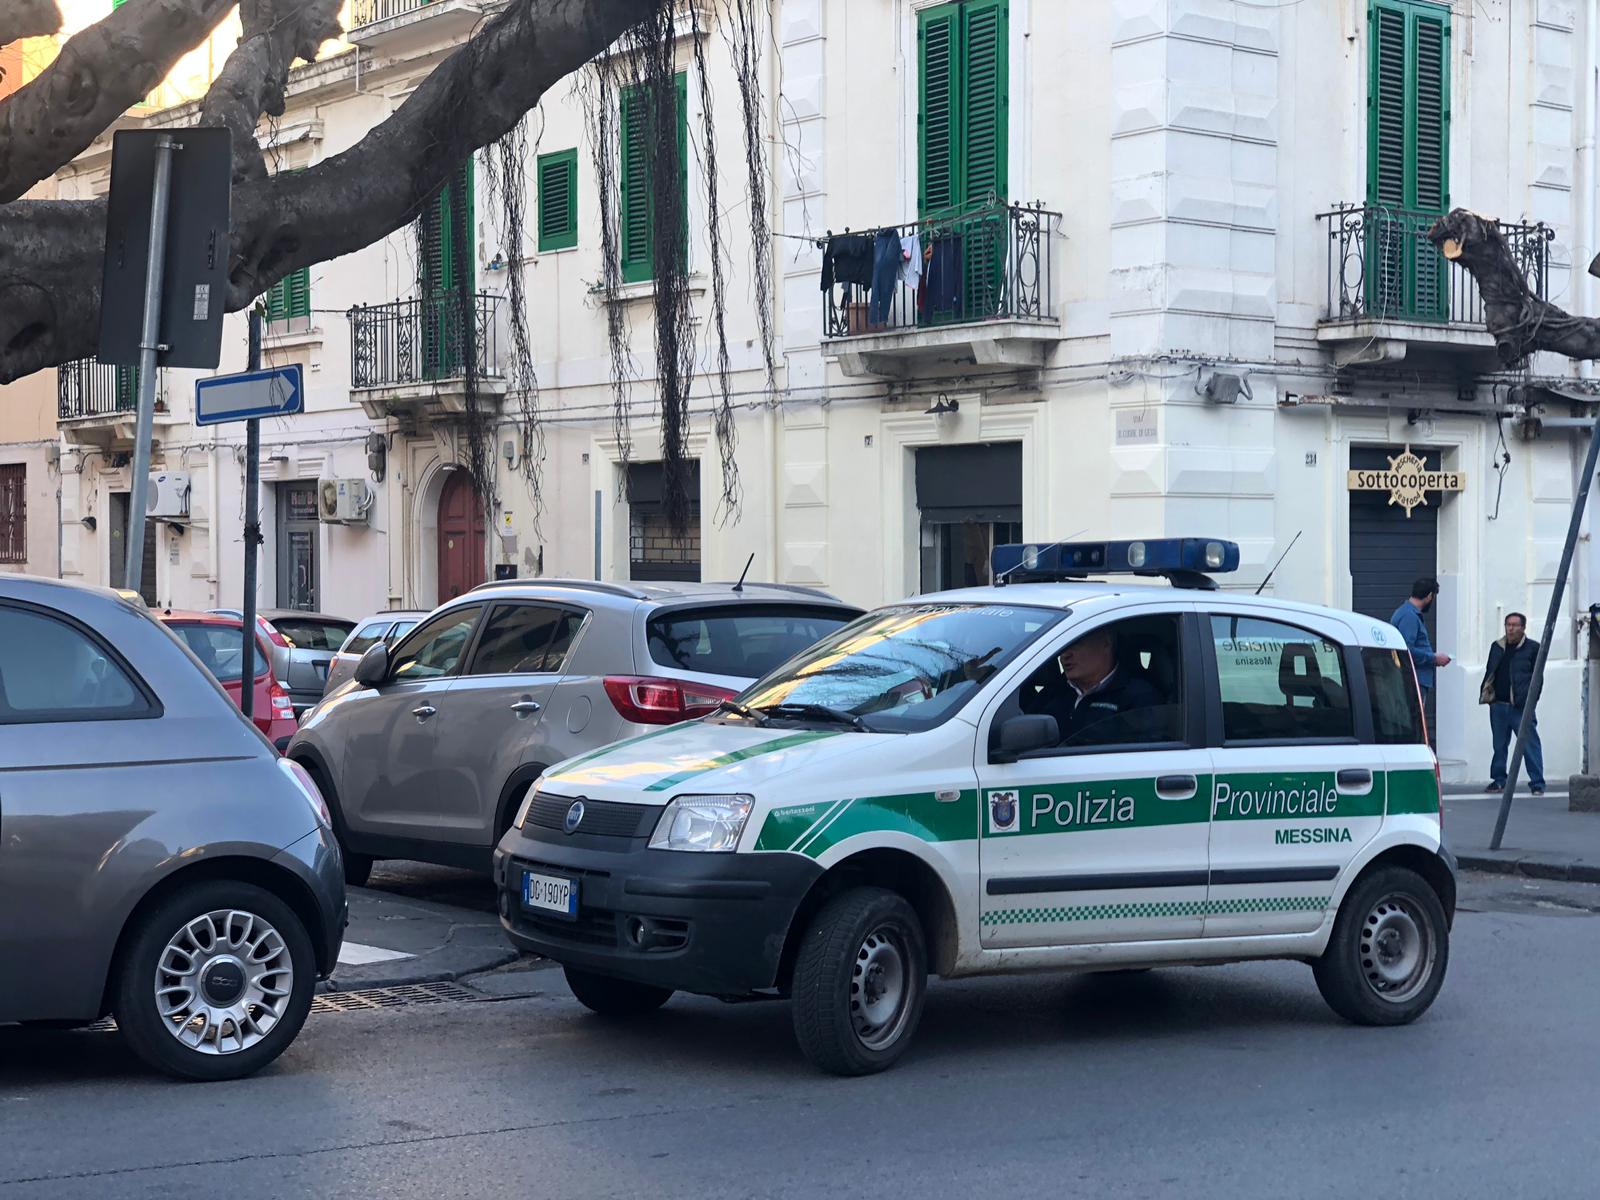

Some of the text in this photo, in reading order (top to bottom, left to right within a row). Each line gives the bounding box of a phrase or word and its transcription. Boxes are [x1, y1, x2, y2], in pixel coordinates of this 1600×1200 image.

[1357, 471, 1459, 491] Sottocoperta
[1031, 789, 1135, 828] Polizia
[1213, 781, 1338, 816] Provinciale
[1275, 828, 1352, 844] MESSINA
